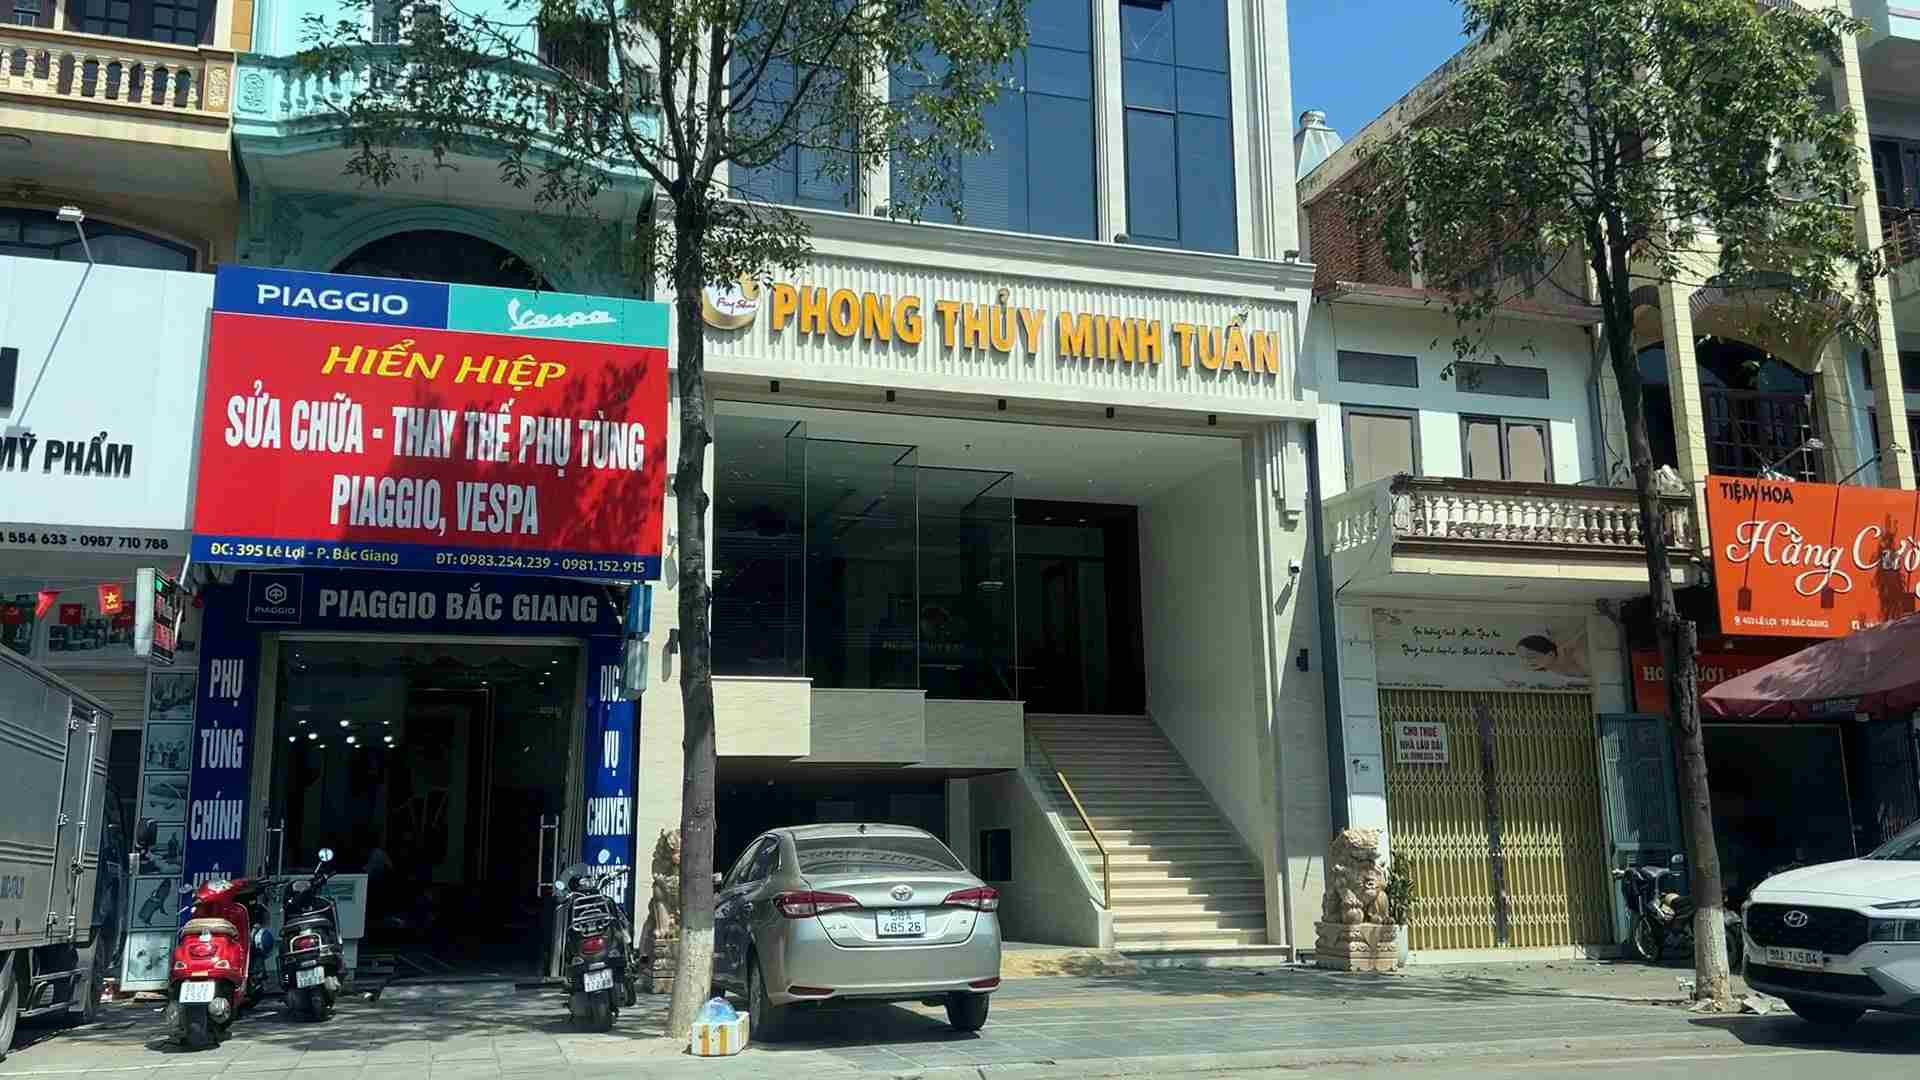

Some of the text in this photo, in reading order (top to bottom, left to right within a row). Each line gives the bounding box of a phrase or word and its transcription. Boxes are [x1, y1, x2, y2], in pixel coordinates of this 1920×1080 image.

[257, 284, 408, 315] PIAGGIO
[507, 298, 616, 331] Vespa
[772, 282, 923, 344] PHONG
[936, 287, 1045, 354] THỦY
[1059, 311, 1162, 365] MINH
[321, 338, 567, 392] HIỂN HIỆP
[224, 379, 281, 449] SỬA
[290, 392, 363, 454] CHỮA
[392, 406, 457, 458] THAY
[464, 397, 515, 463] THẾ
[518, 415, 572, 478] PHỤ
[579, 410, 645, 472] TÙNG
[43, 431, 133, 479] PHẨM
[330, 474, 540, 537] PIAGGIO, VESPA
[1720, 481, 1794, 504] TIỆM HOA
[8, 532, 37, 545] 554
[41, 533, 67, 545] 633
[80, 534, 114, 547] 0987
[118, 535, 141, 549] 710
[211, 542, 234, 555] ĐC:
[237, 544, 263, 557] 395
[266, 545, 283, 558] Lê
[360, 550, 399, 565] Giang
[435, 552, 458, 565] ĐT:
[460, 553, 551, 569] 0983.254.239
[562, 558, 646, 573] 0981.152.915
[319, 583, 598, 623] PIAGGIO BẮC GIANG
[209, 659, 244, 707] PHỤ
[200, 719, 244, 769] TÙNG
[604, 730, 620, 776] VỤ
[190, 791, 243, 841] CHÍNH
[586, 788, 632, 836] CHUYÊN
